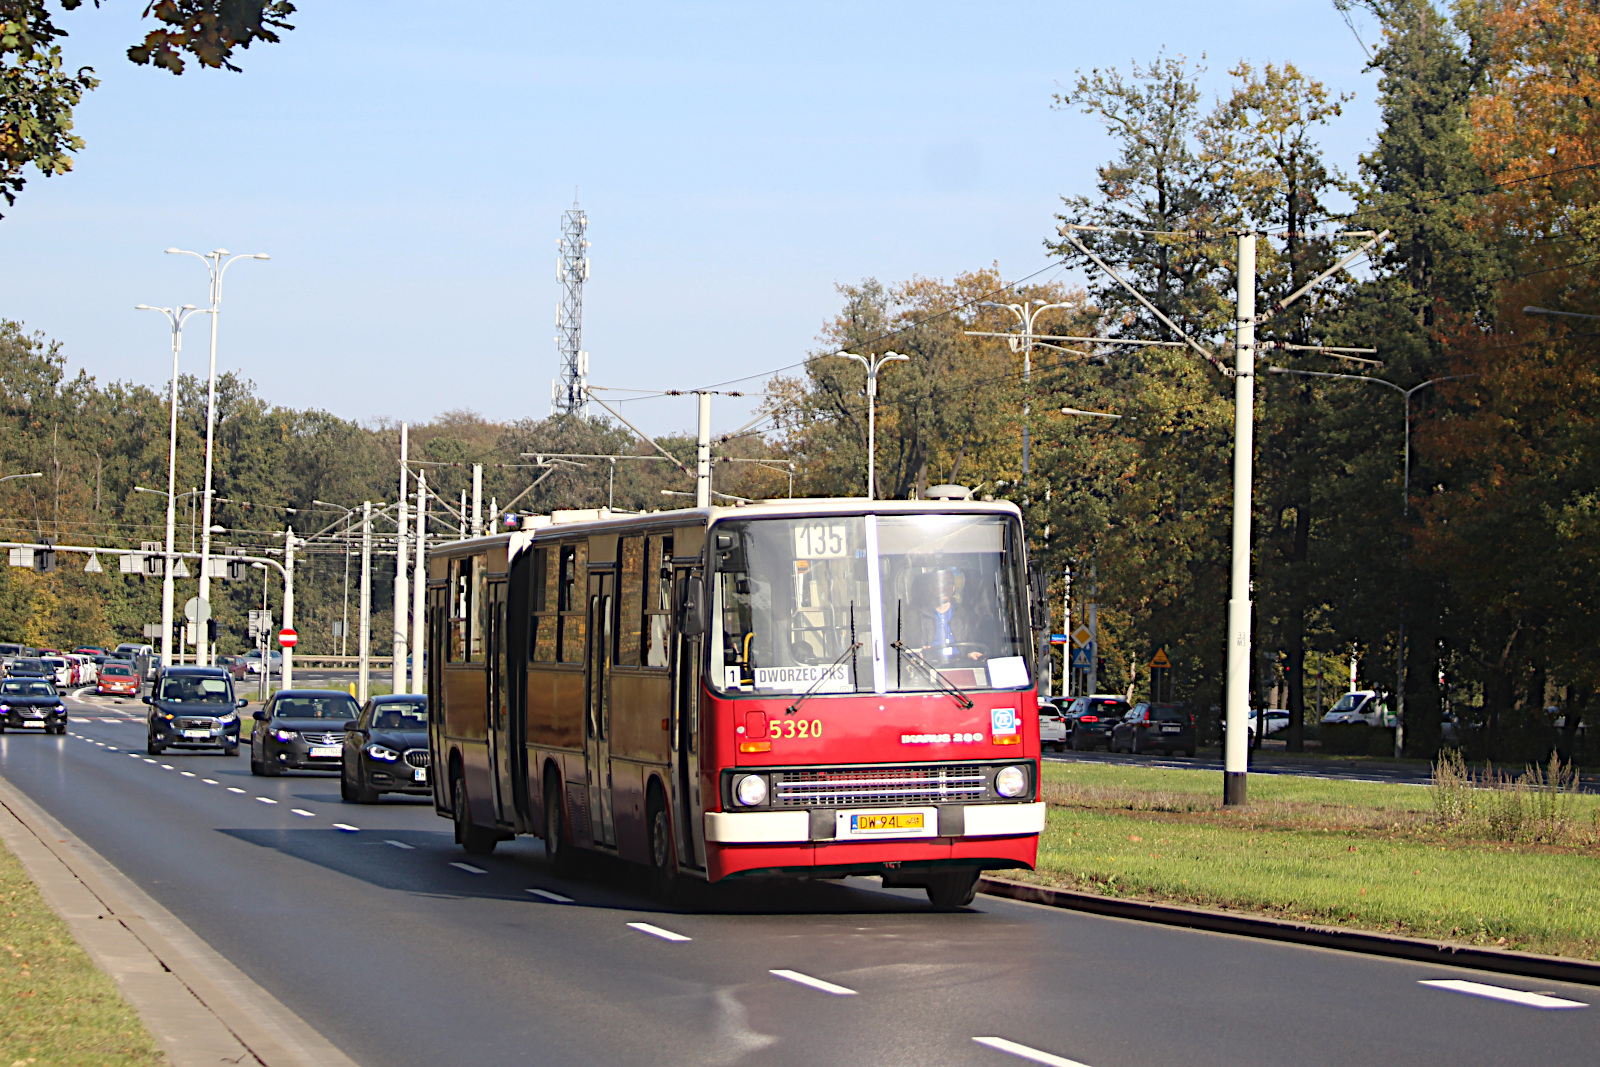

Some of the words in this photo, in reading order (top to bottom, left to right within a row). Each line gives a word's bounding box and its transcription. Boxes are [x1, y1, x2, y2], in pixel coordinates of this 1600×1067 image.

[800, 522, 843, 555] 135
[730, 670, 735, 683] 1
[759, 668, 817, 683] DWORZEC
[821, 666, 845, 681] PKS
[769, 719, 822, 739] 5320
[901, 733, 951, 744] IKARUS
[952, 732, 984, 743] 280
[860, 816, 876, 829] DW
[880, 815, 903, 828] 94L
